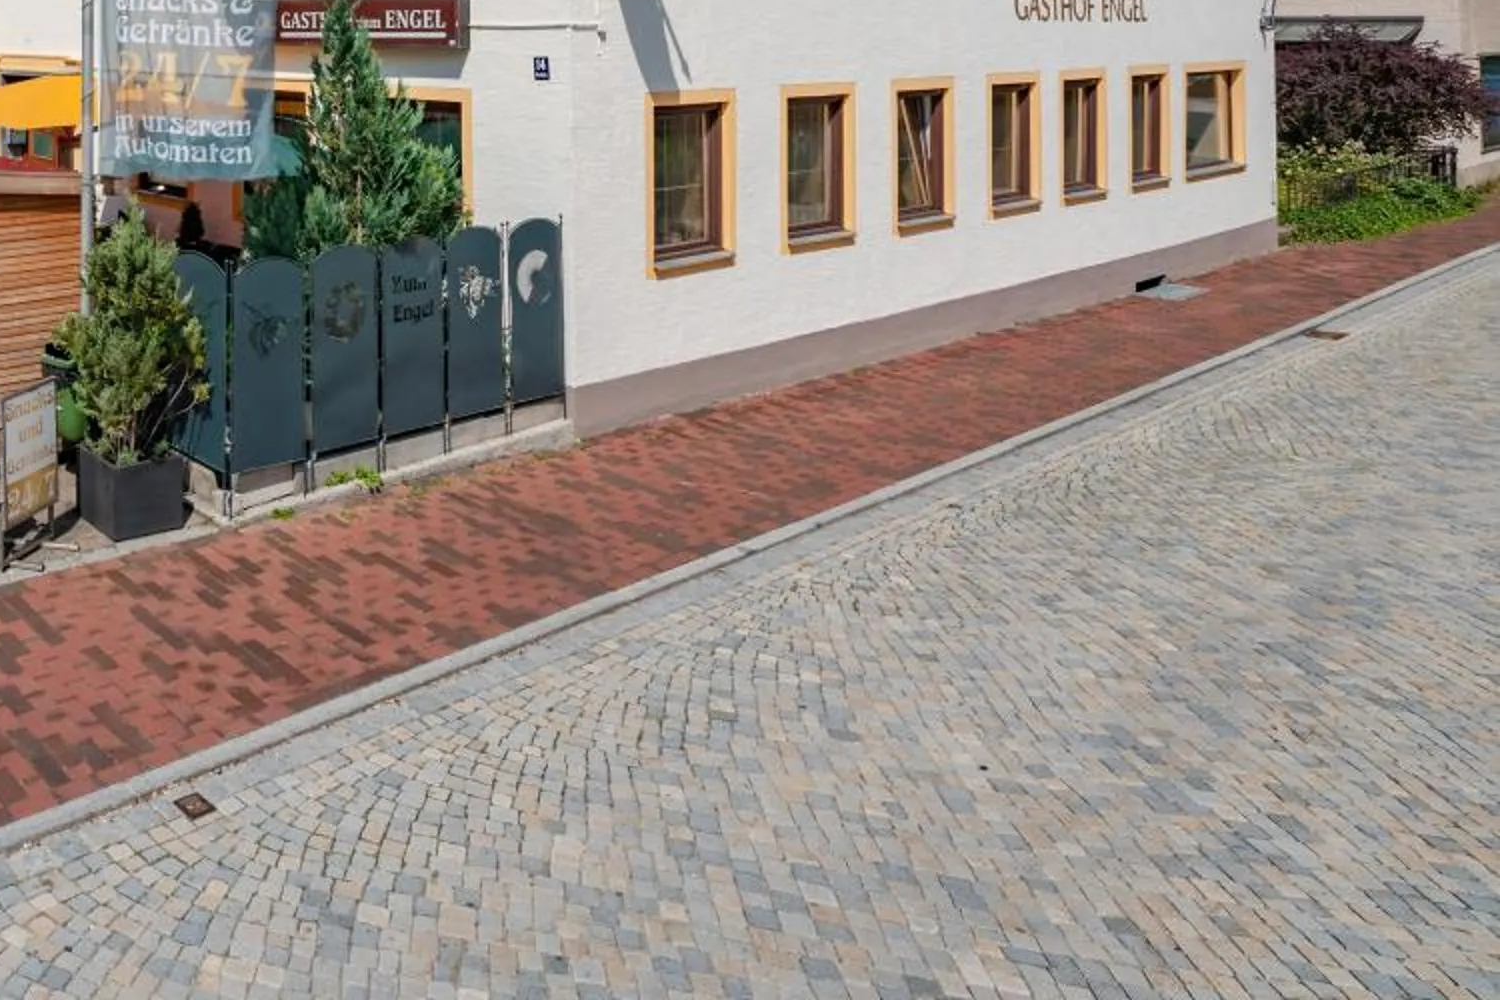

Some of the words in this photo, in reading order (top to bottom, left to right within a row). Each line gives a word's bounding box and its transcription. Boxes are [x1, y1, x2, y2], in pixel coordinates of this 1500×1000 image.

[115, 15, 255, 47] Getränke
[385, 9, 447, 29] ENGEL
[116, 51, 254, 109] 24/7
[115, 112, 133, 131] in
[141, 115, 252, 137] unserem
[115, 135, 253, 165] Automaten
[393, 300, 434, 324] Engel
[18, 413, 43, 443] und
